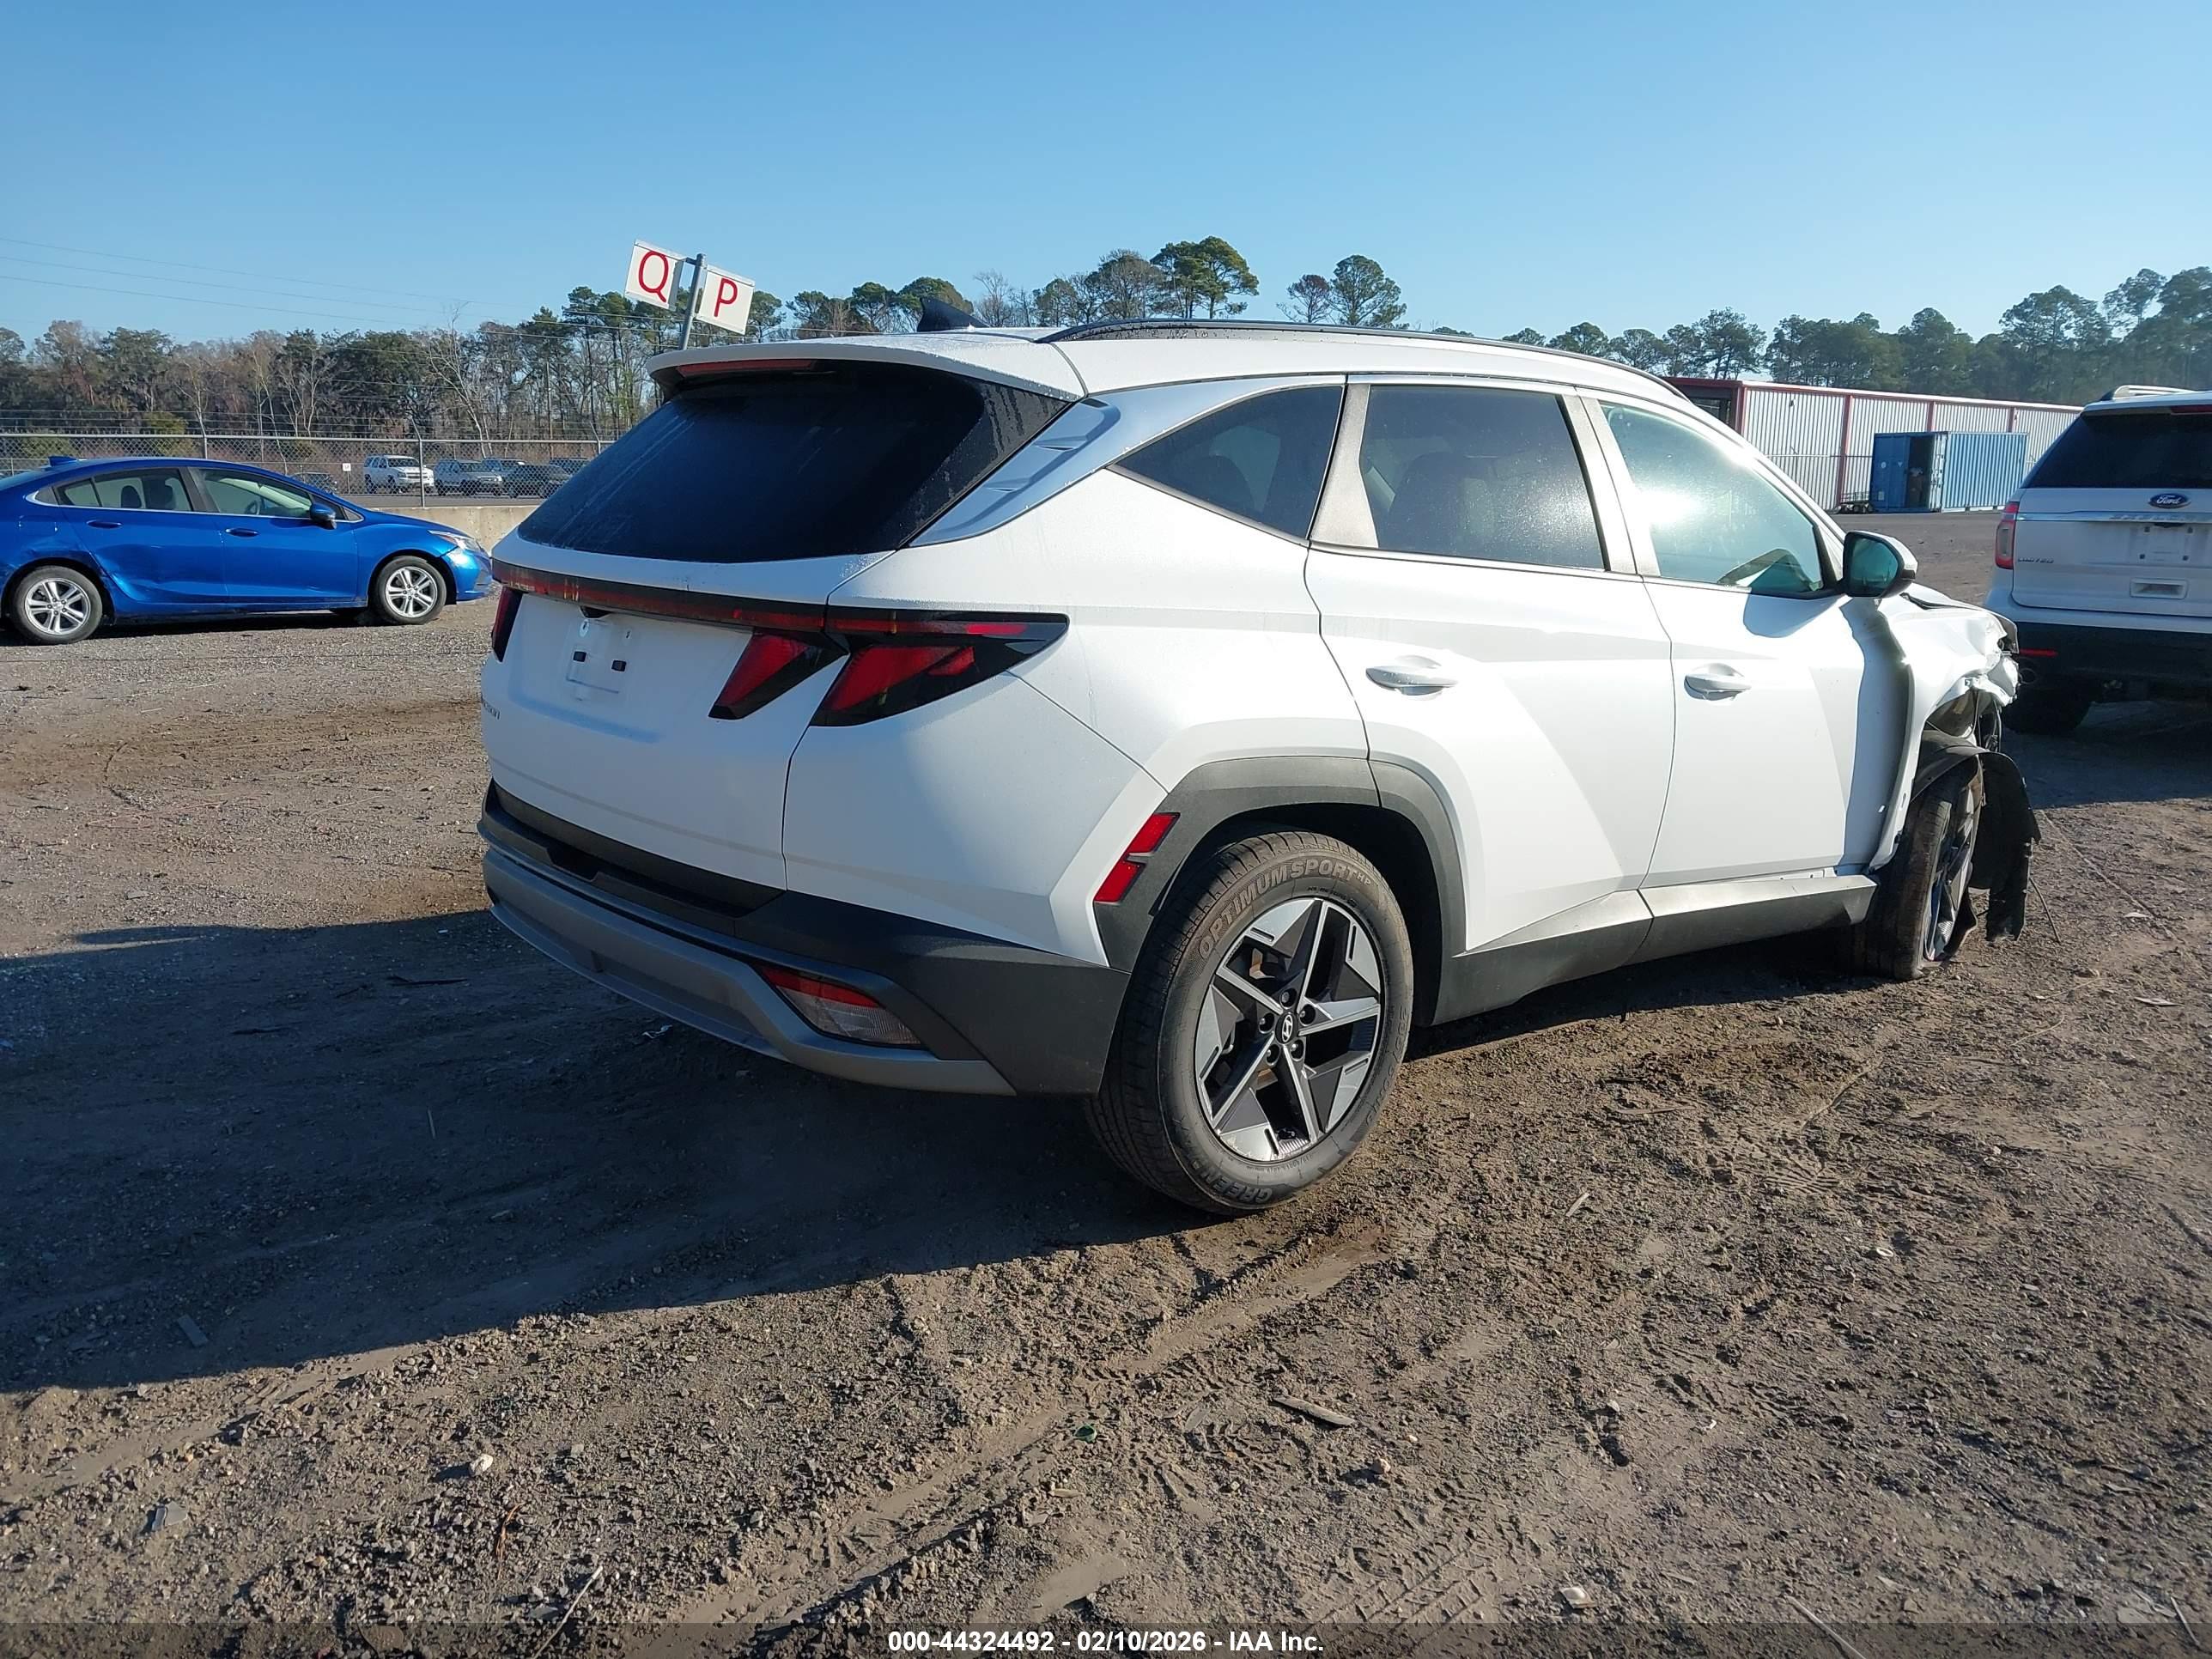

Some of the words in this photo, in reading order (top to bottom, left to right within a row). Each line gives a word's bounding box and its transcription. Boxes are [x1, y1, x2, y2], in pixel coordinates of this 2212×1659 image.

[638, 250, 669, 303] Q
[714, 277, 738, 317] P
[1357, 873, 1372, 887] HP
